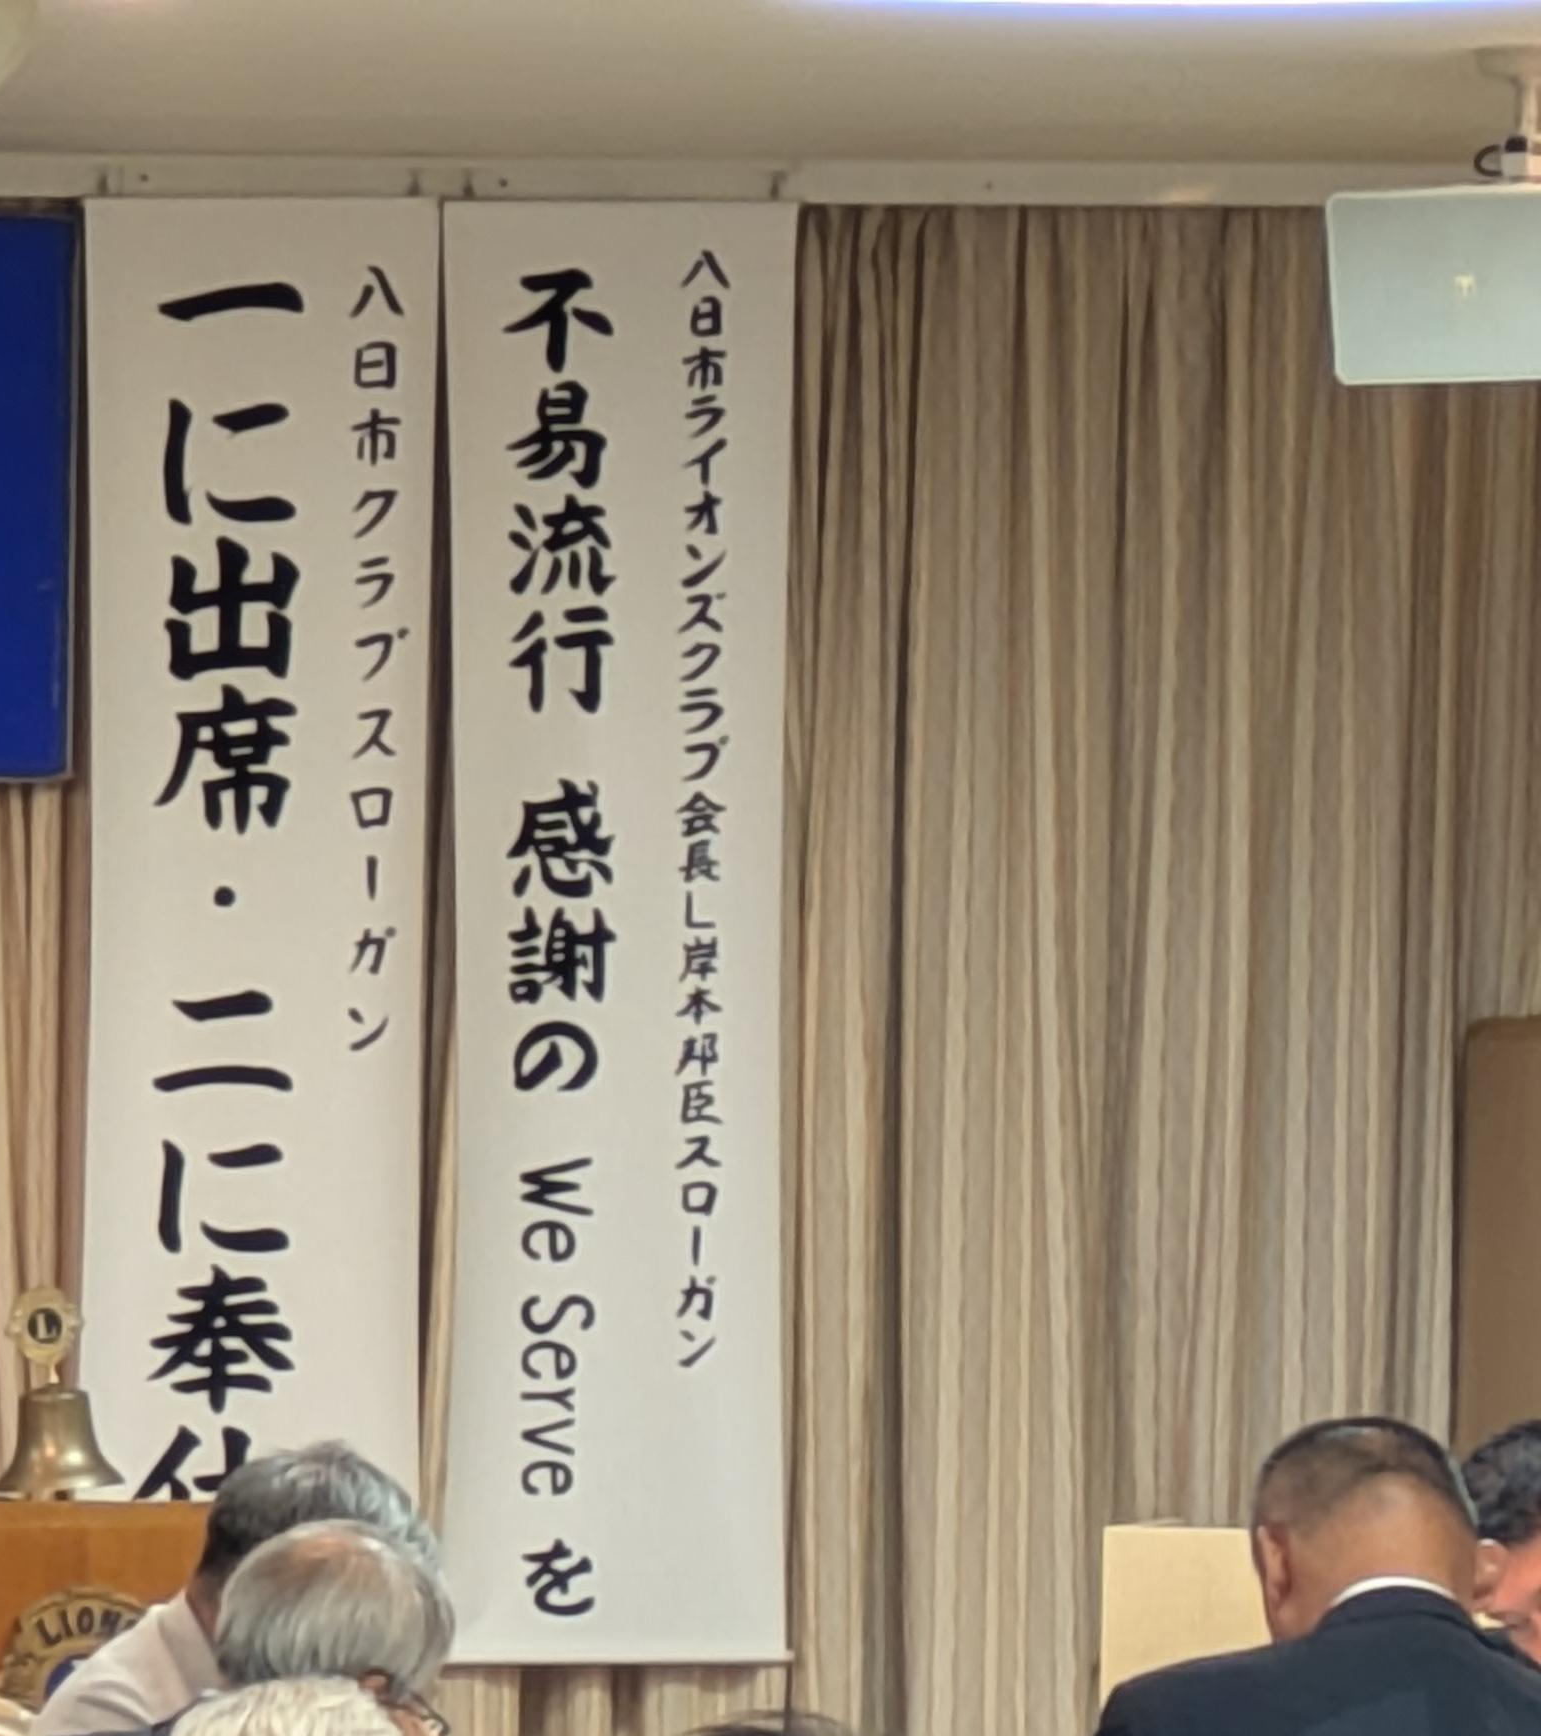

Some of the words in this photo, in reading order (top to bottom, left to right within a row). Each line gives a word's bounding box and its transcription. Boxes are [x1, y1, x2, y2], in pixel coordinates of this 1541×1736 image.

[504, 268, 616, 713] 不易流行
[349, 266, 408, 1051] 八日市クラブスローガン
[506, 779, 616, 1091] 感謝の
[520, 1158, 593, 1262] We
[521, 1295, 595, 1495] Serve
[522, 1539, 594, 1616] を
